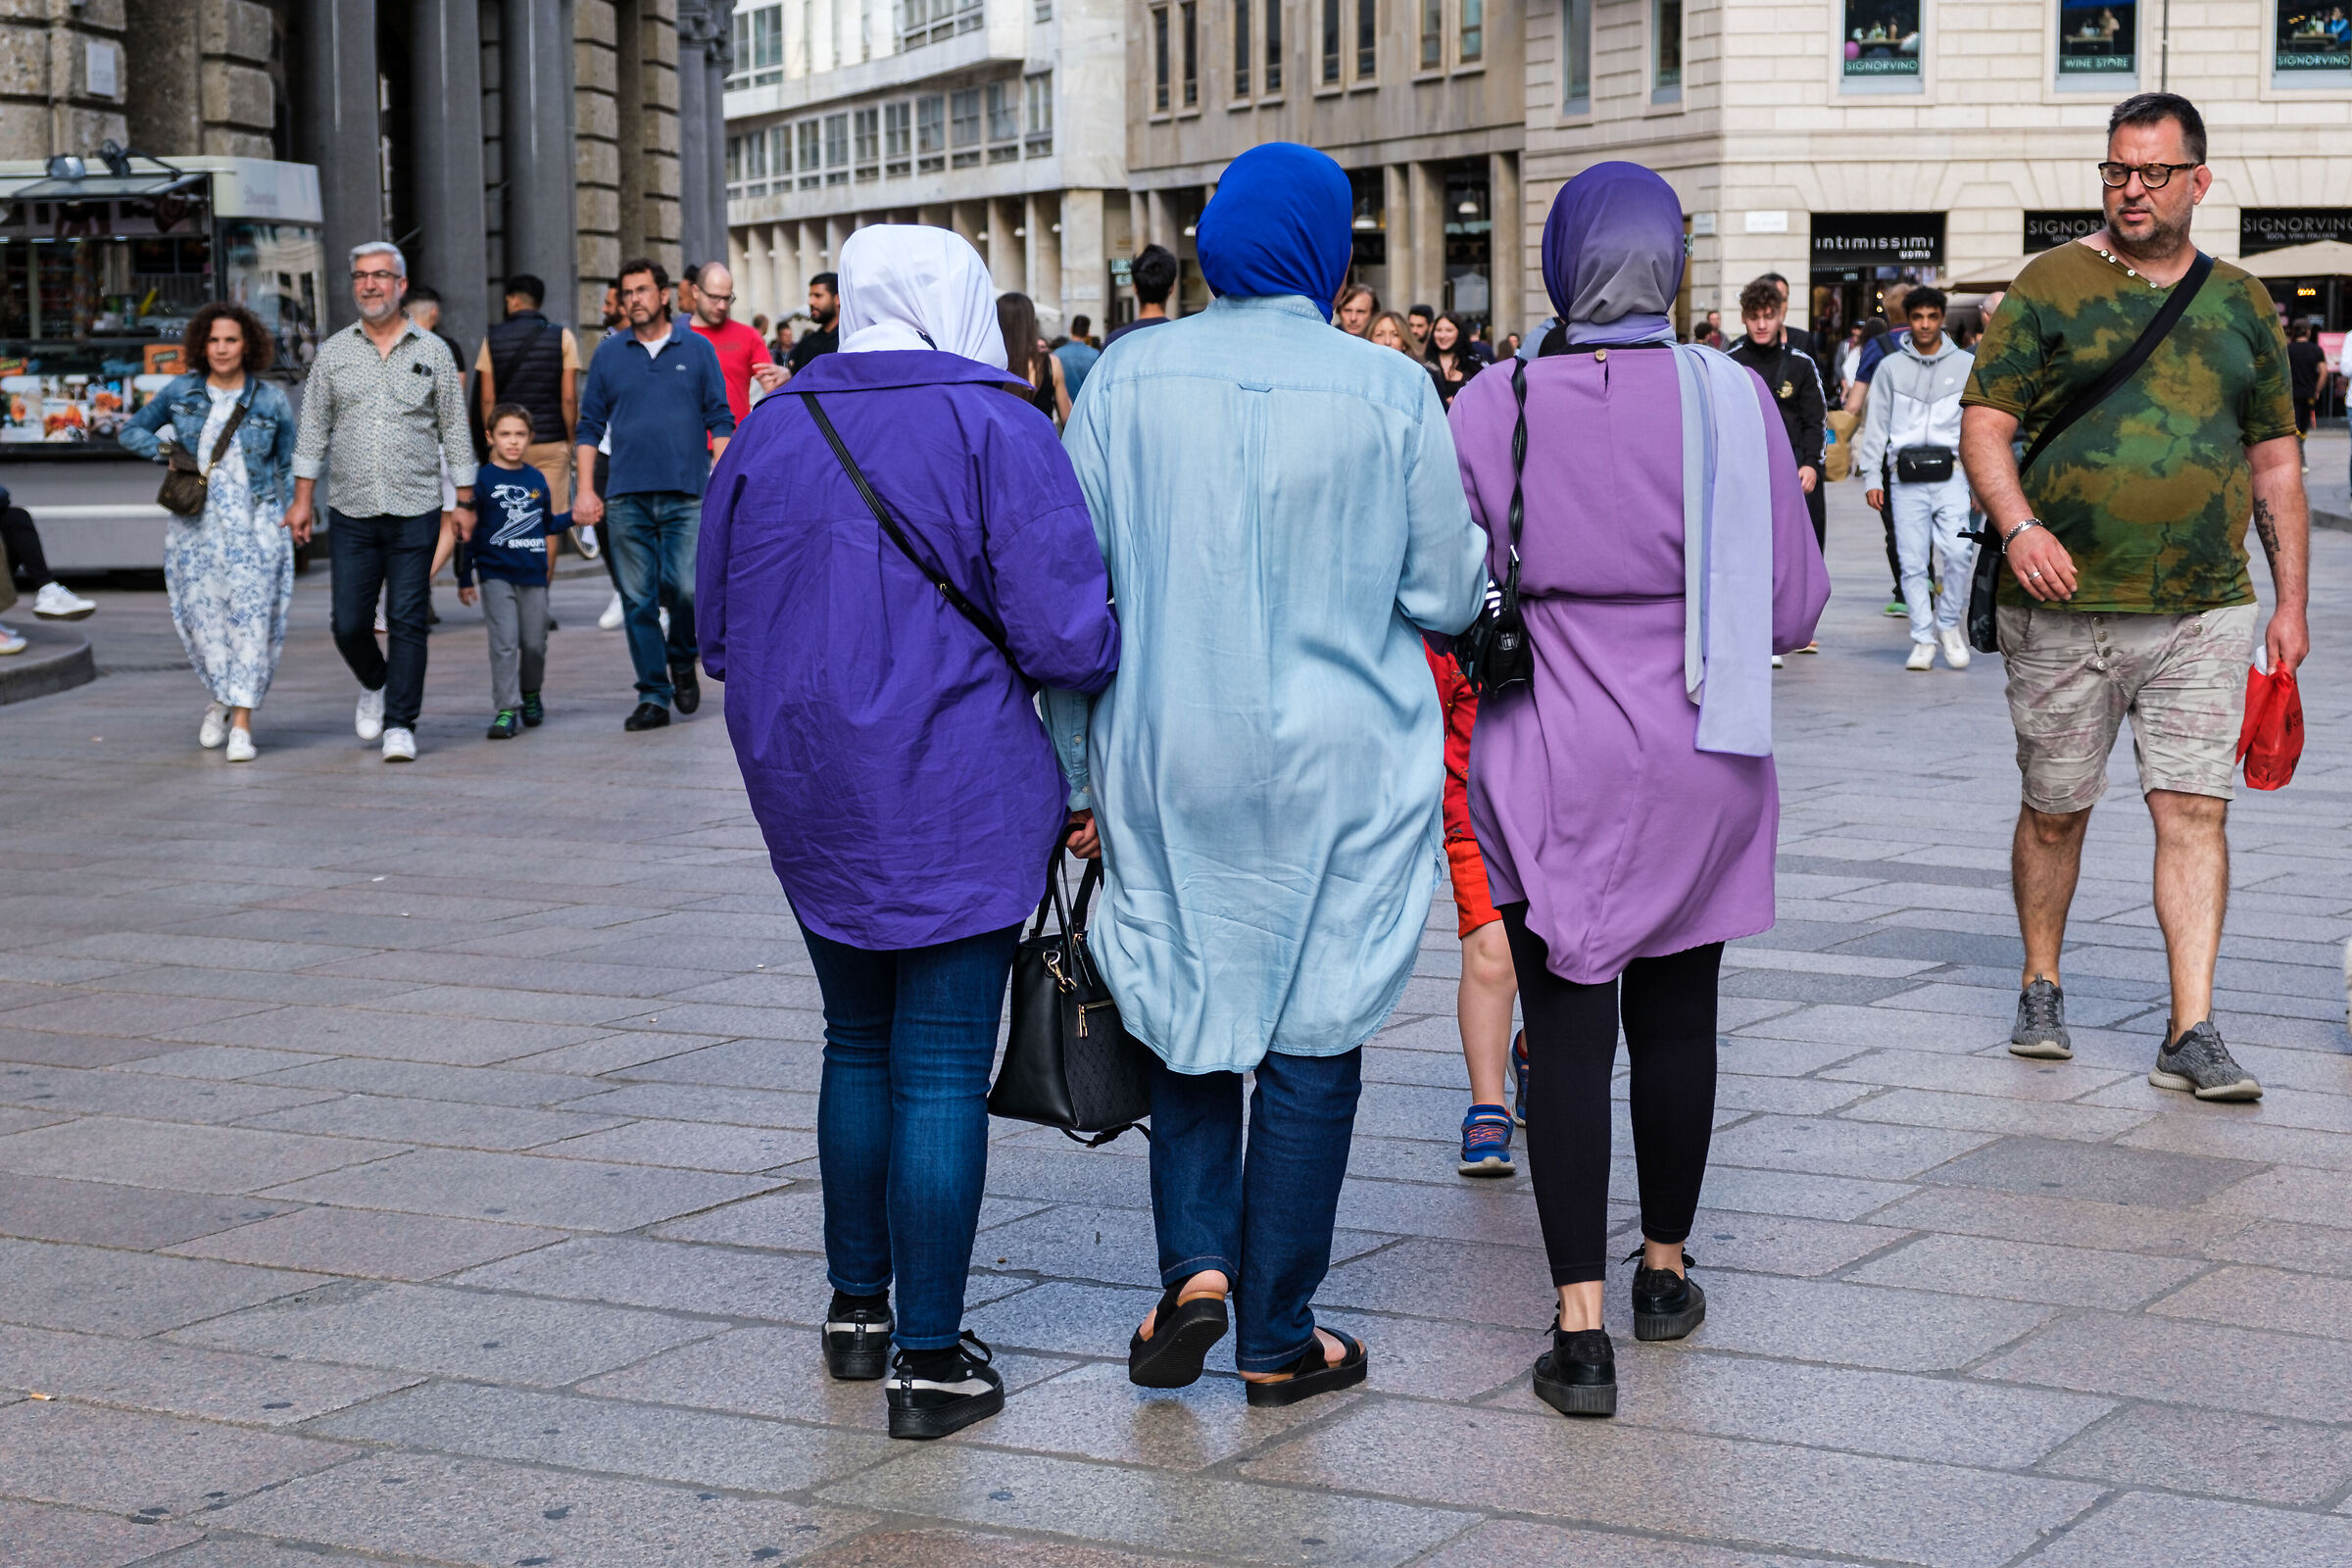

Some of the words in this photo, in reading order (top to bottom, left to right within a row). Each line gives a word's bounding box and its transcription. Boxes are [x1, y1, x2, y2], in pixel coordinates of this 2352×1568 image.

[2065, 58, 2091, 69] WINE
[2095, 58, 2129, 69] STORE
[2277, 55, 2350, 66] SIGNORVINO
[1845, 61, 1918, 72] SIGNORVINO
[1815, 235, 1935, 250] intimissimi
[1898, 250, 1931, 260] uomo
